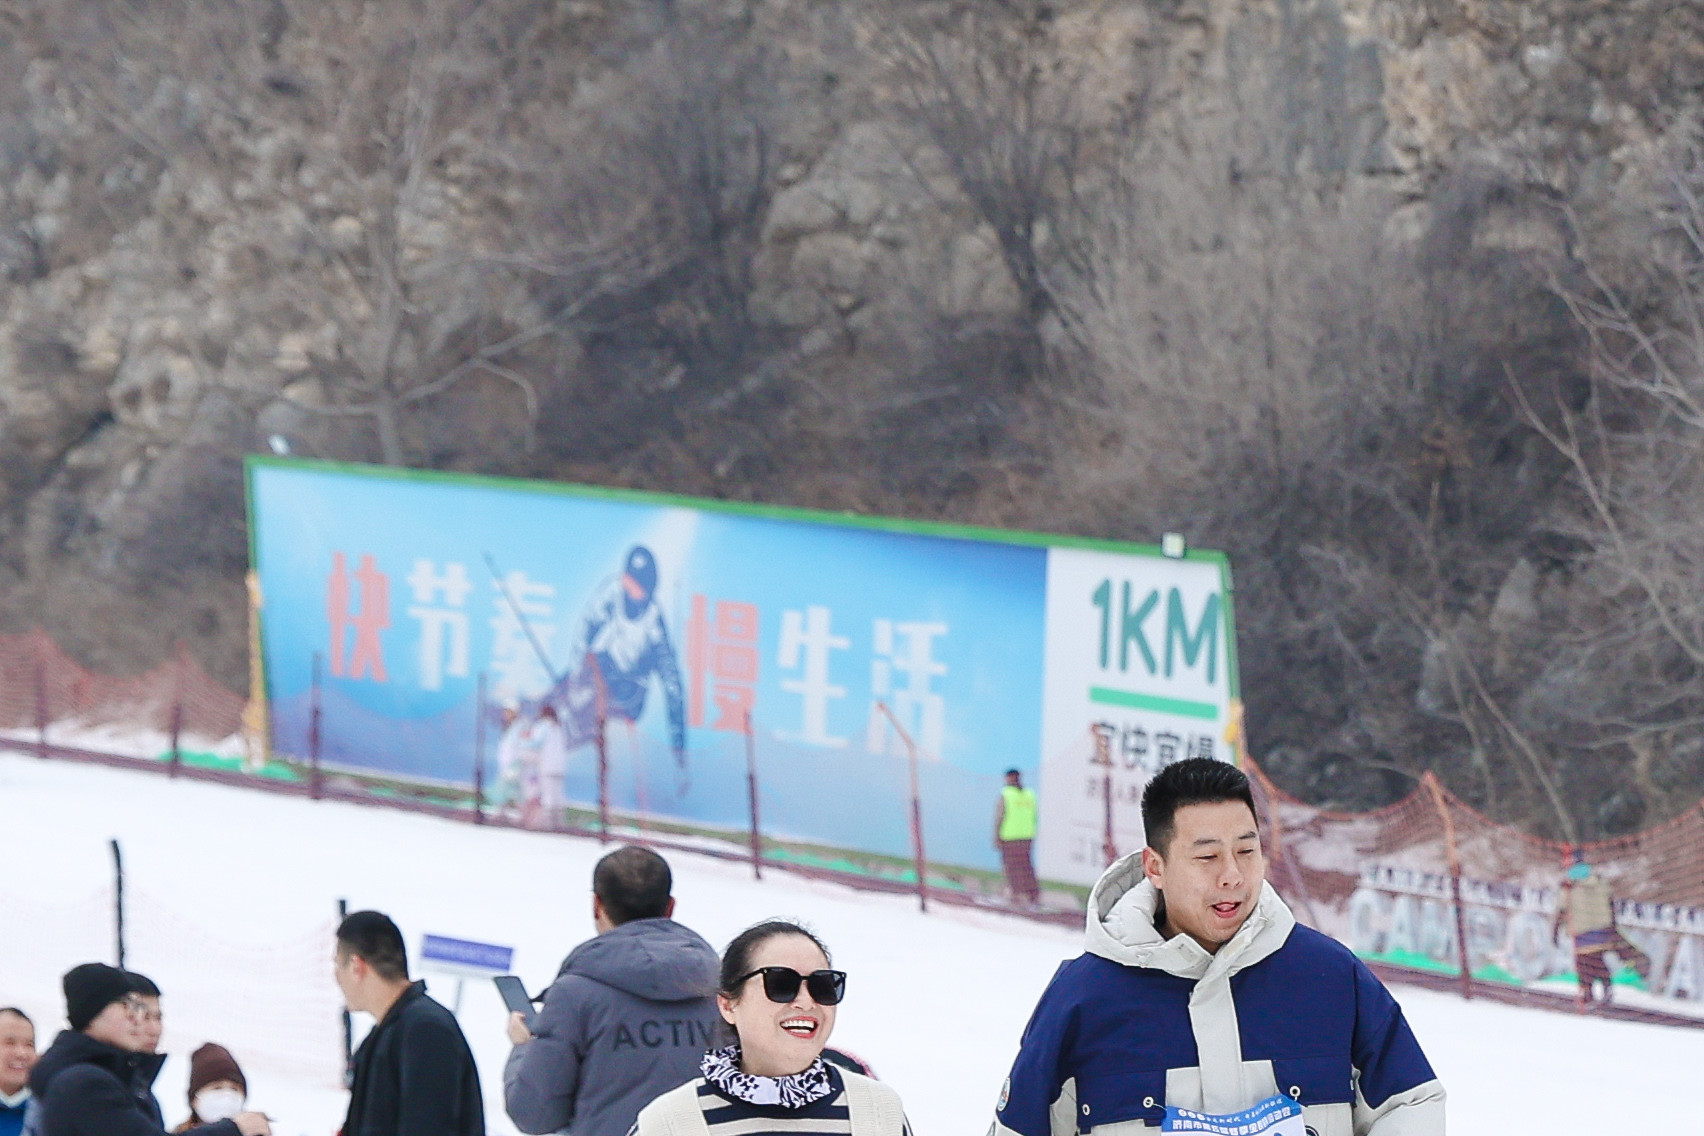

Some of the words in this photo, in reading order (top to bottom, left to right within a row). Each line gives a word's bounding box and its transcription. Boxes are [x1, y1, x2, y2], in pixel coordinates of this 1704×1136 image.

[325, 550, 559, 703] 快节奏
[685, 593, 951, 762] 慢生活
[1091, 577, 1223, 687] 1KM
